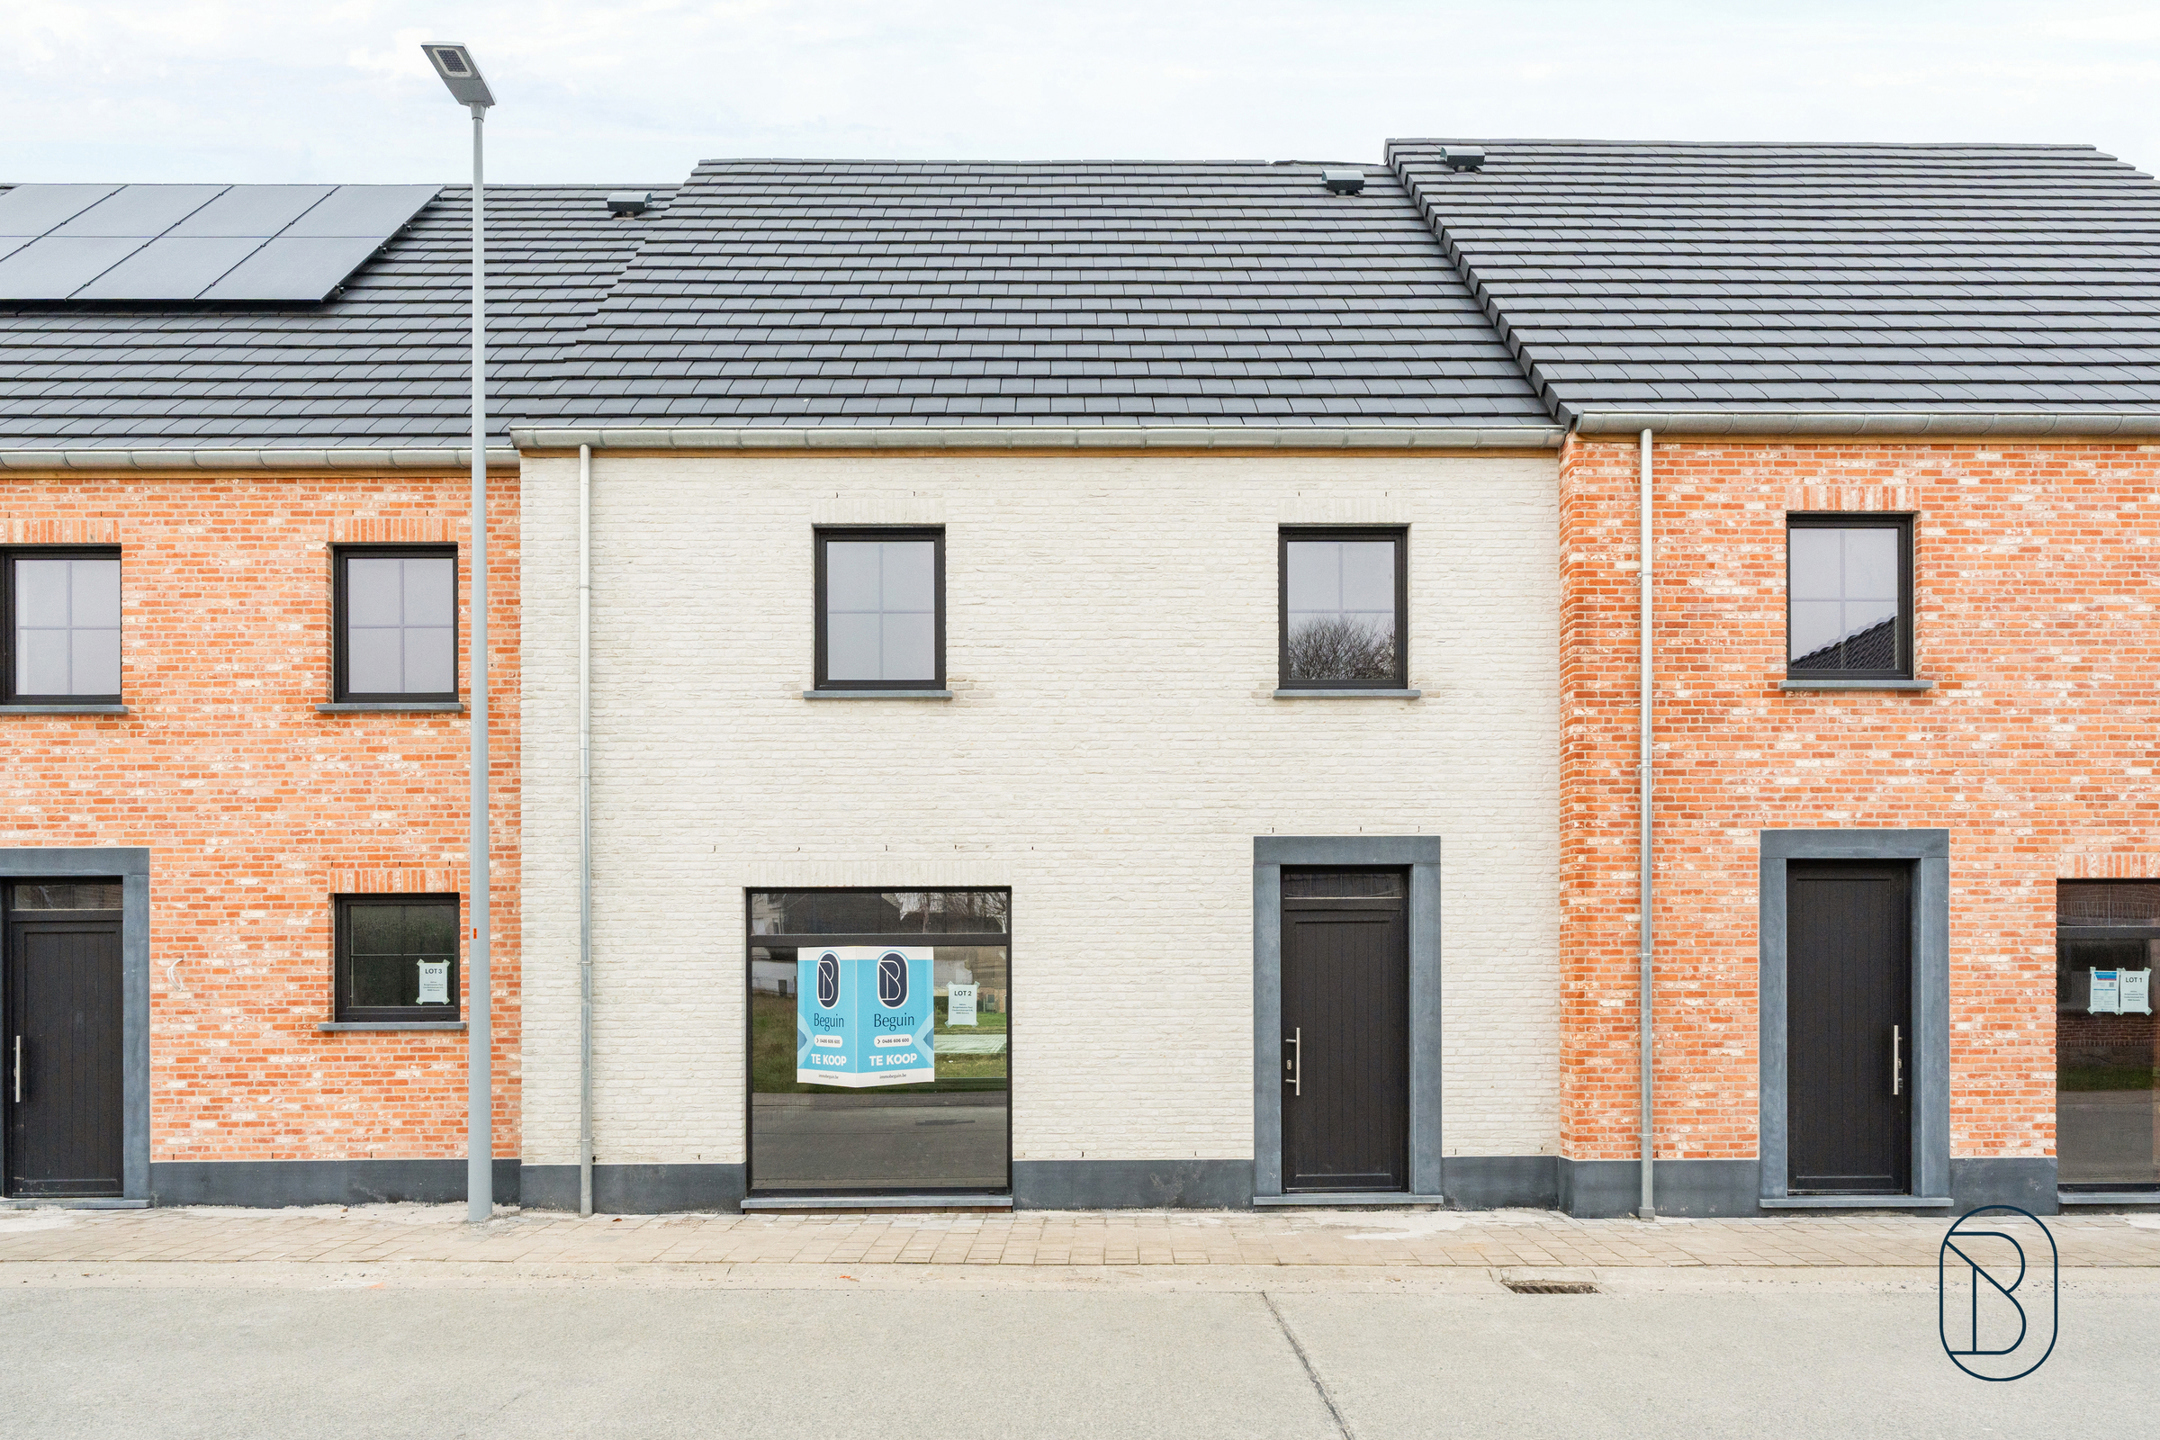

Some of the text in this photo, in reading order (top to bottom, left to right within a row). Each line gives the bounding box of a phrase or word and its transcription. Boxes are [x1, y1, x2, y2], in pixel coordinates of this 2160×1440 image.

[813, 1012, 845, 1032] Beguin
[874, 1012, 915, 1032] Beguin
[811, 1053, 847, 1066] TE KOOP
[869, 1053, 918, 1066] TE KOOP
